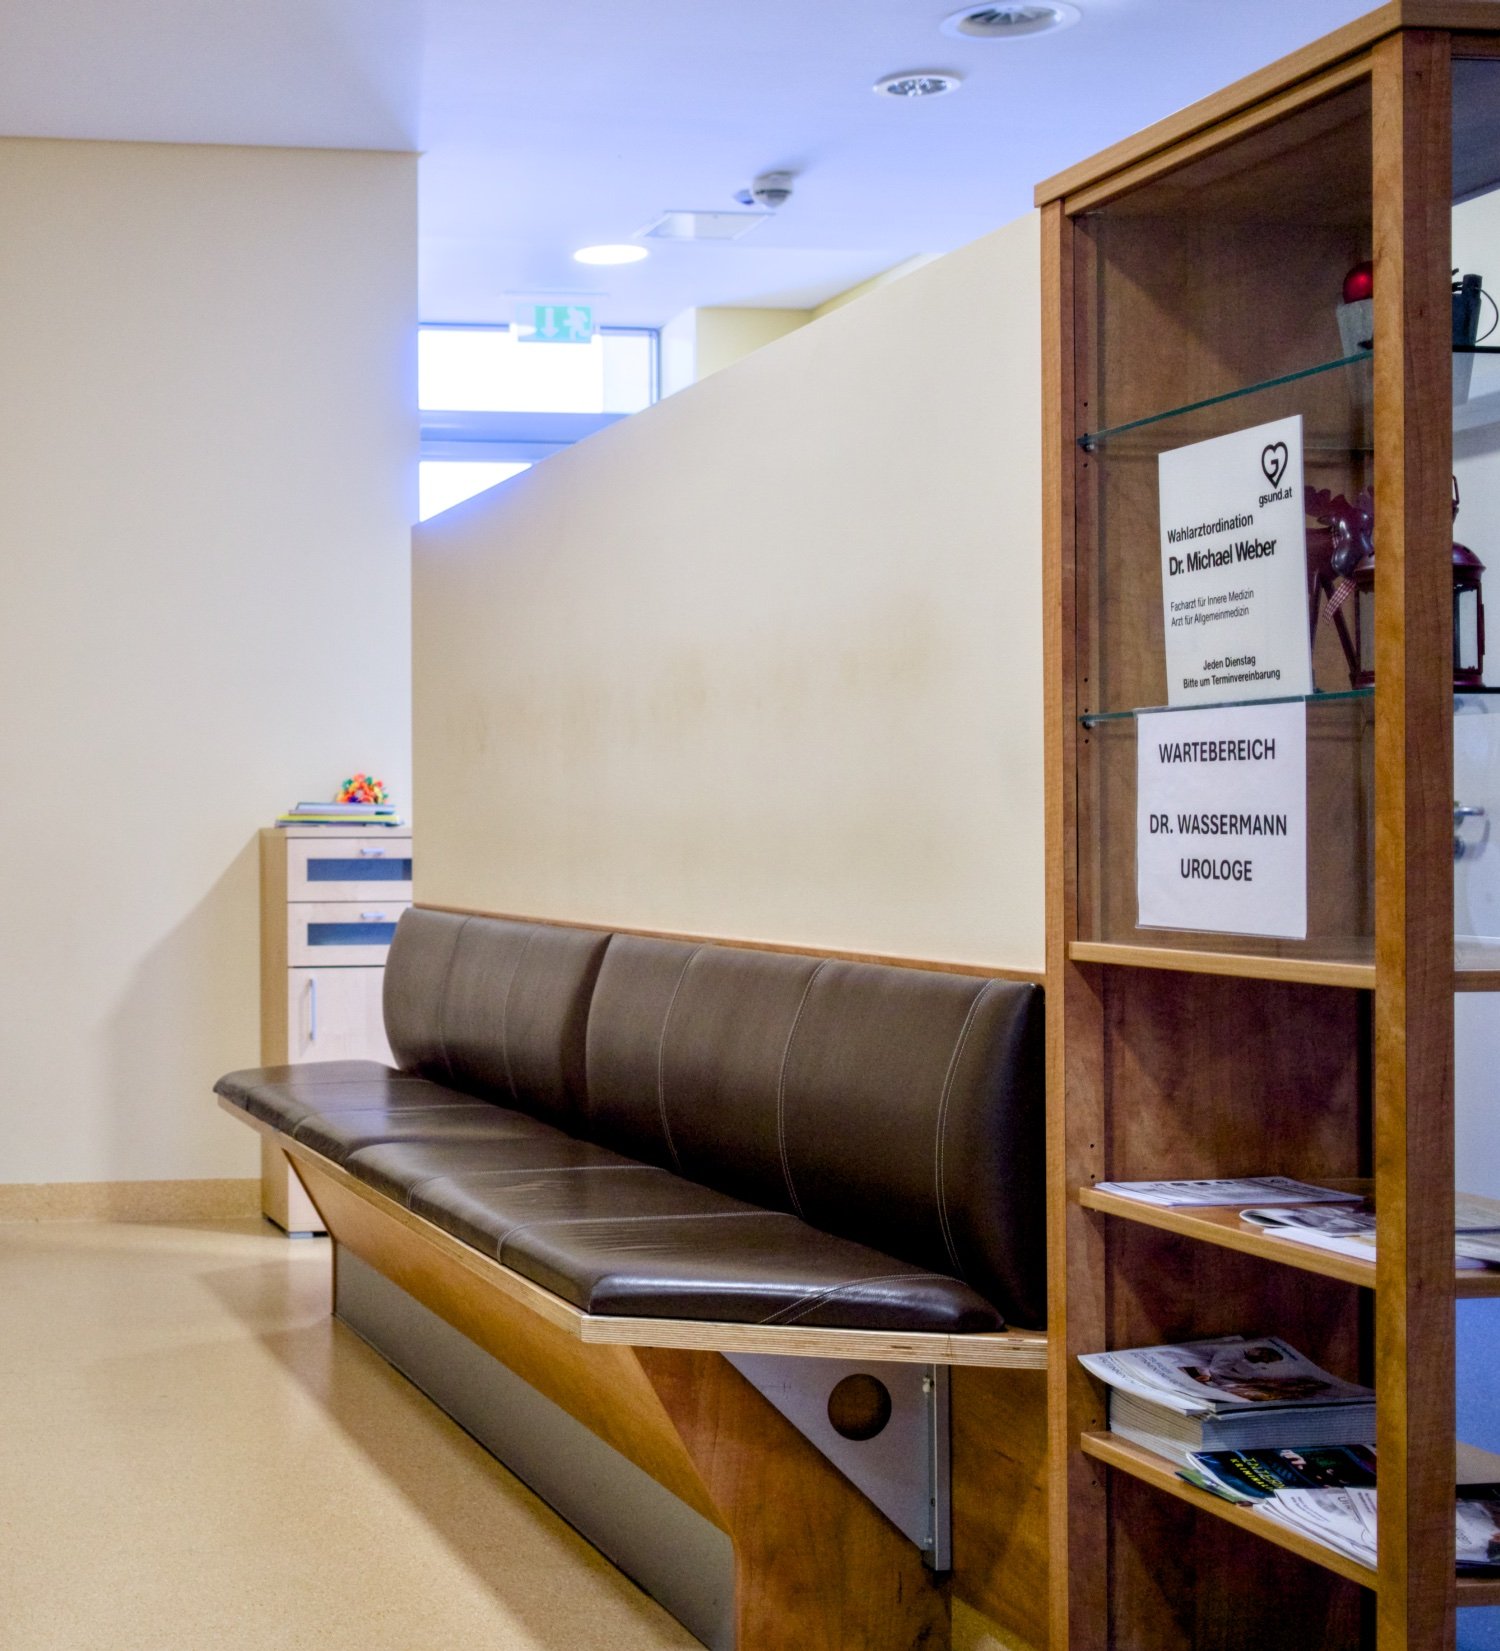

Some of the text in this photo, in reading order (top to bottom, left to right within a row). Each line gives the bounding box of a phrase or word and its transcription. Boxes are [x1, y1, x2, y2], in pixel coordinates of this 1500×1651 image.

[1259, 487, 1292, 507] gsund.at
[1167, 514, 1253, 544] Wahlarztordination
[1169, 538, 1277, 576] Dr. Michael Weber
[1170, 588, 1254, 612] Facharzt für Innere Medizin
[1171, 605, 1250, 627] Arzt für Allgemeinmedizin
[1203, 654, 1256, 671] Jeden Dienstag
[1183, 669, 1281, 689] Bitte um Terminvereinbarung
[1159, 738, 1276, 763] WARTEBEREICH
[1150, 814, 1287, 836] DR. WASSERMANN
[1181, 858, 1253, 881] UROLOGE
